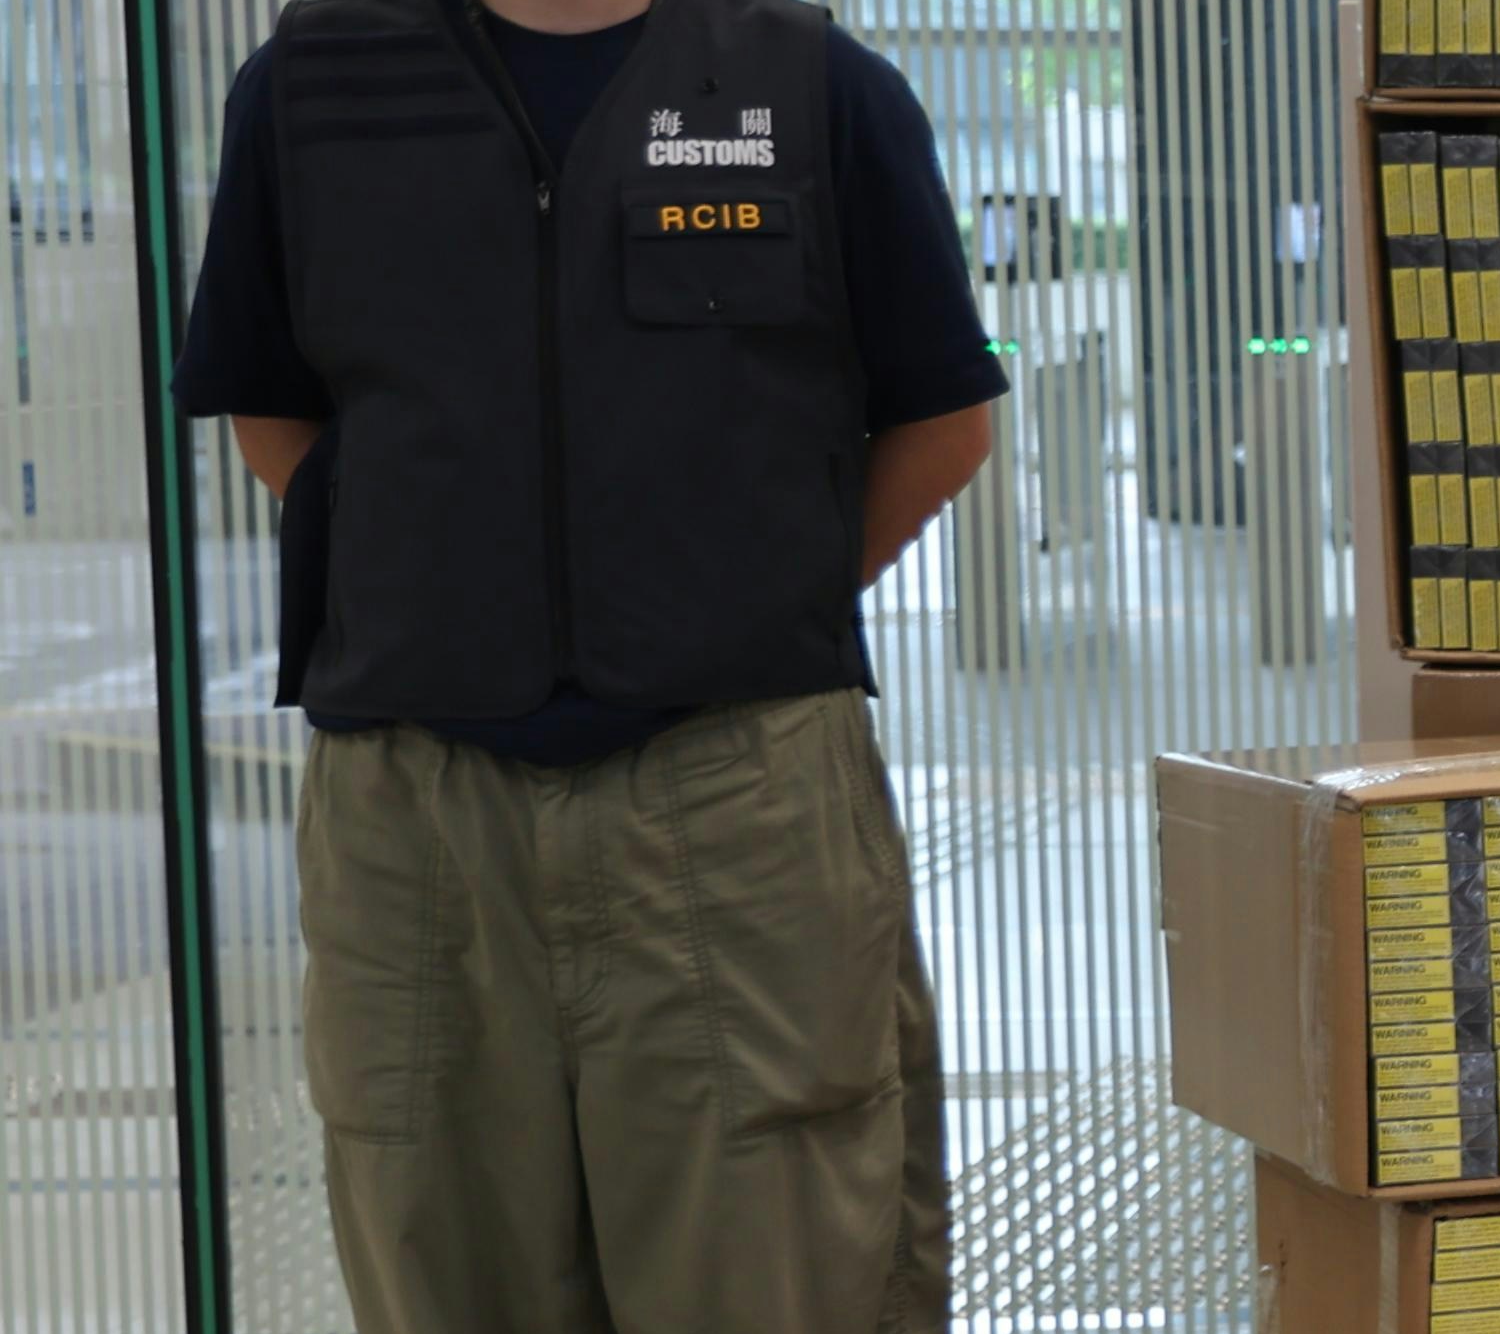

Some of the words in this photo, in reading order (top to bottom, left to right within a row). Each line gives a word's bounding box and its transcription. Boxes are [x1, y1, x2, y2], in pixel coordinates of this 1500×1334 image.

[650, 107, 772, 137] 海關
[647, 139, 775, 167] CUSTOMS
[660, 203, 761, 231] RCIB
[1365, 838, 1419, 849] WARNING
[1368, 869, 1422, 880] WARNING
[1368, 901, 1422, 912] WARNING
[1371, 932, 1425, 943] WARNING
[1372, 964, 1426, 975] WARNING
[1373, 996, 1427, 1007] WARNING
[1374, 1027, 1428, 1038] WARNING
[1378, 1059, 1432, 1070] WARNING
[1378, 1091, 1432, 1102] WARNING
[1380, 1123, 1434, 1134] WARNING
[1380, 1155, 1434, 1166] WARNING
